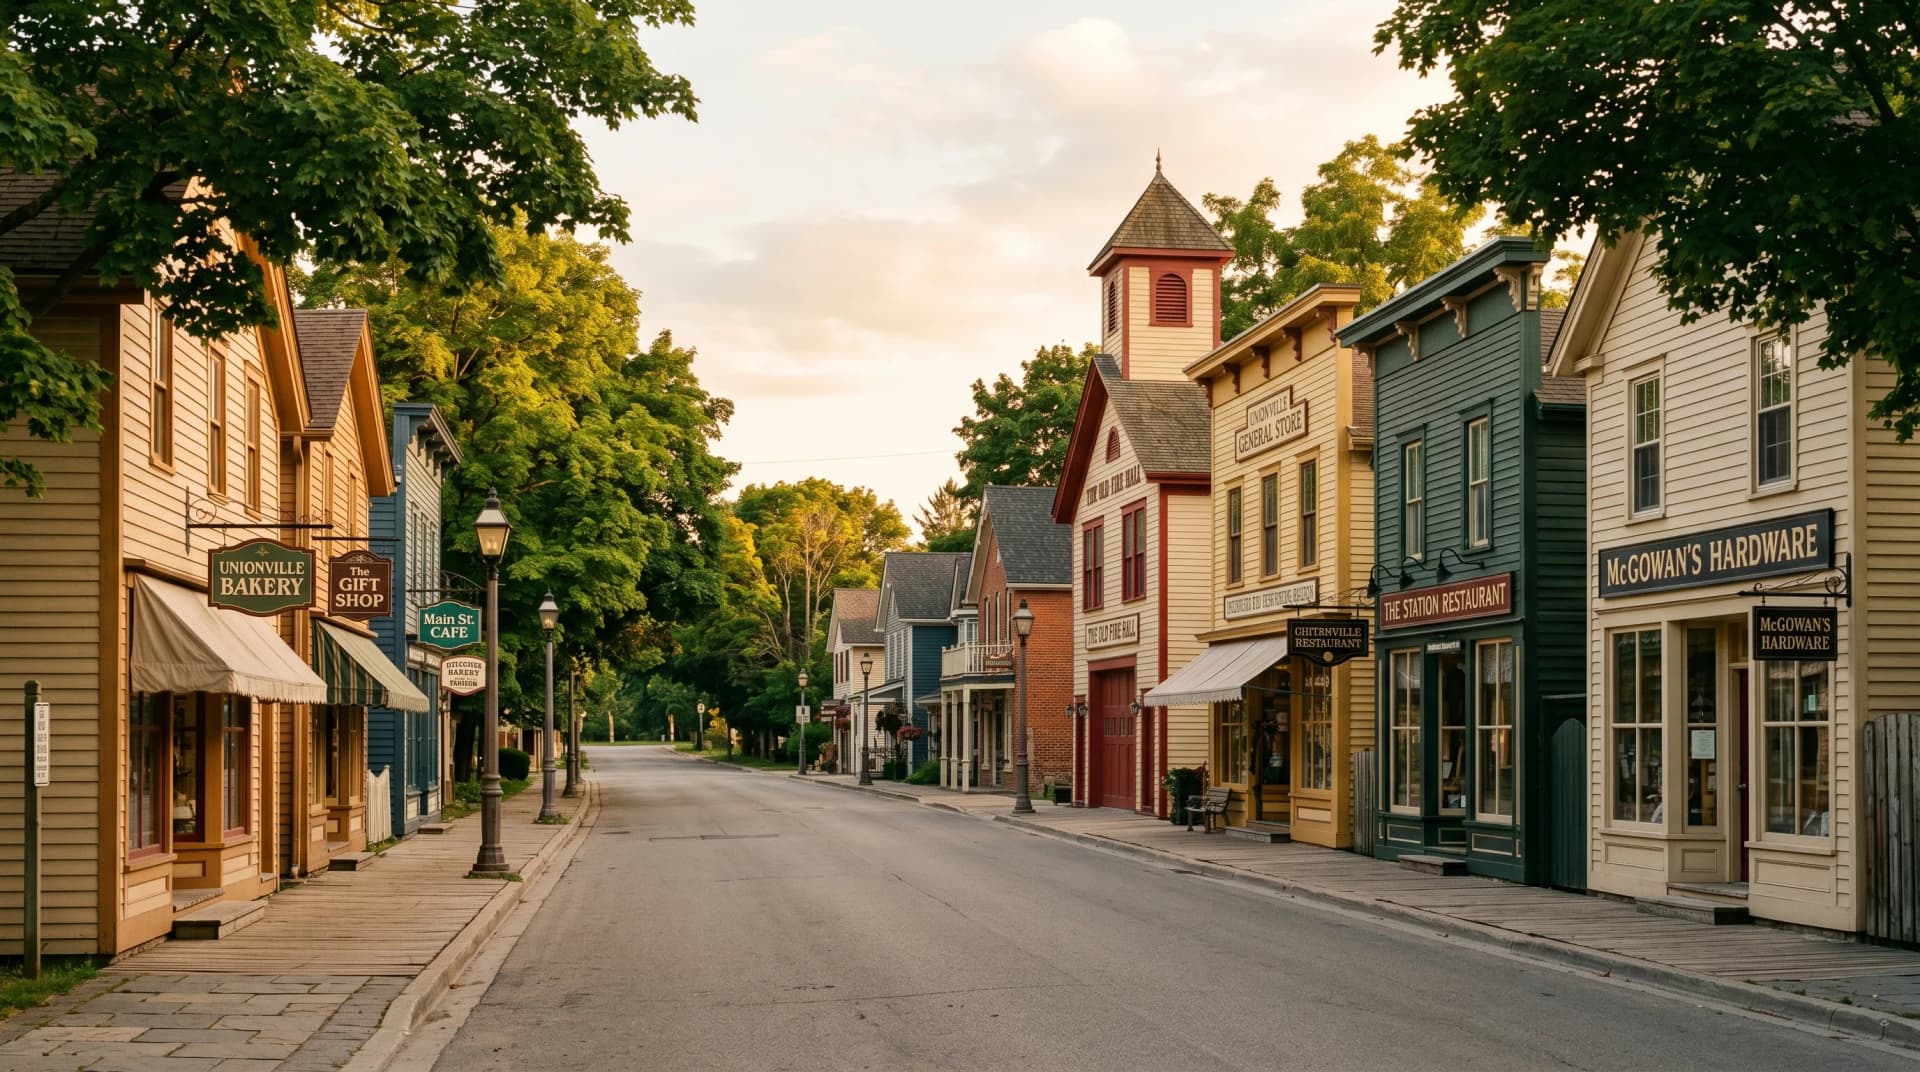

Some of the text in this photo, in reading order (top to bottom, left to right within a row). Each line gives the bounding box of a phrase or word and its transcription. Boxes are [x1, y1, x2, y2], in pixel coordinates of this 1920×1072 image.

[1250, 396, 1287, 426] UNIONVILLE
[1239, 410, 1302, 453] GENERAL STORE
[1607, 523, 1818, 587] McGOWAN'S HARDWARE
[219, 561, 305, 575] UNIONVILLE
[350, 567, 370, 576] The
[220, 577, 304, 596] BAKERY
[339, 578, 381, 592] GIFT
[335, 594, 384, 608] SHOP
[1384, 582, 1506, 621] THE STATION RESTAURANT
[424, 613, 455, 625] Main
[1760, 616, 1831, 632] McGOWAN'S
[430, 626, 469, 639] CAFE
[1295, 638, 1362, 648] RESTAURANT
[1761, 635, 1830, 650] HARDWARE
